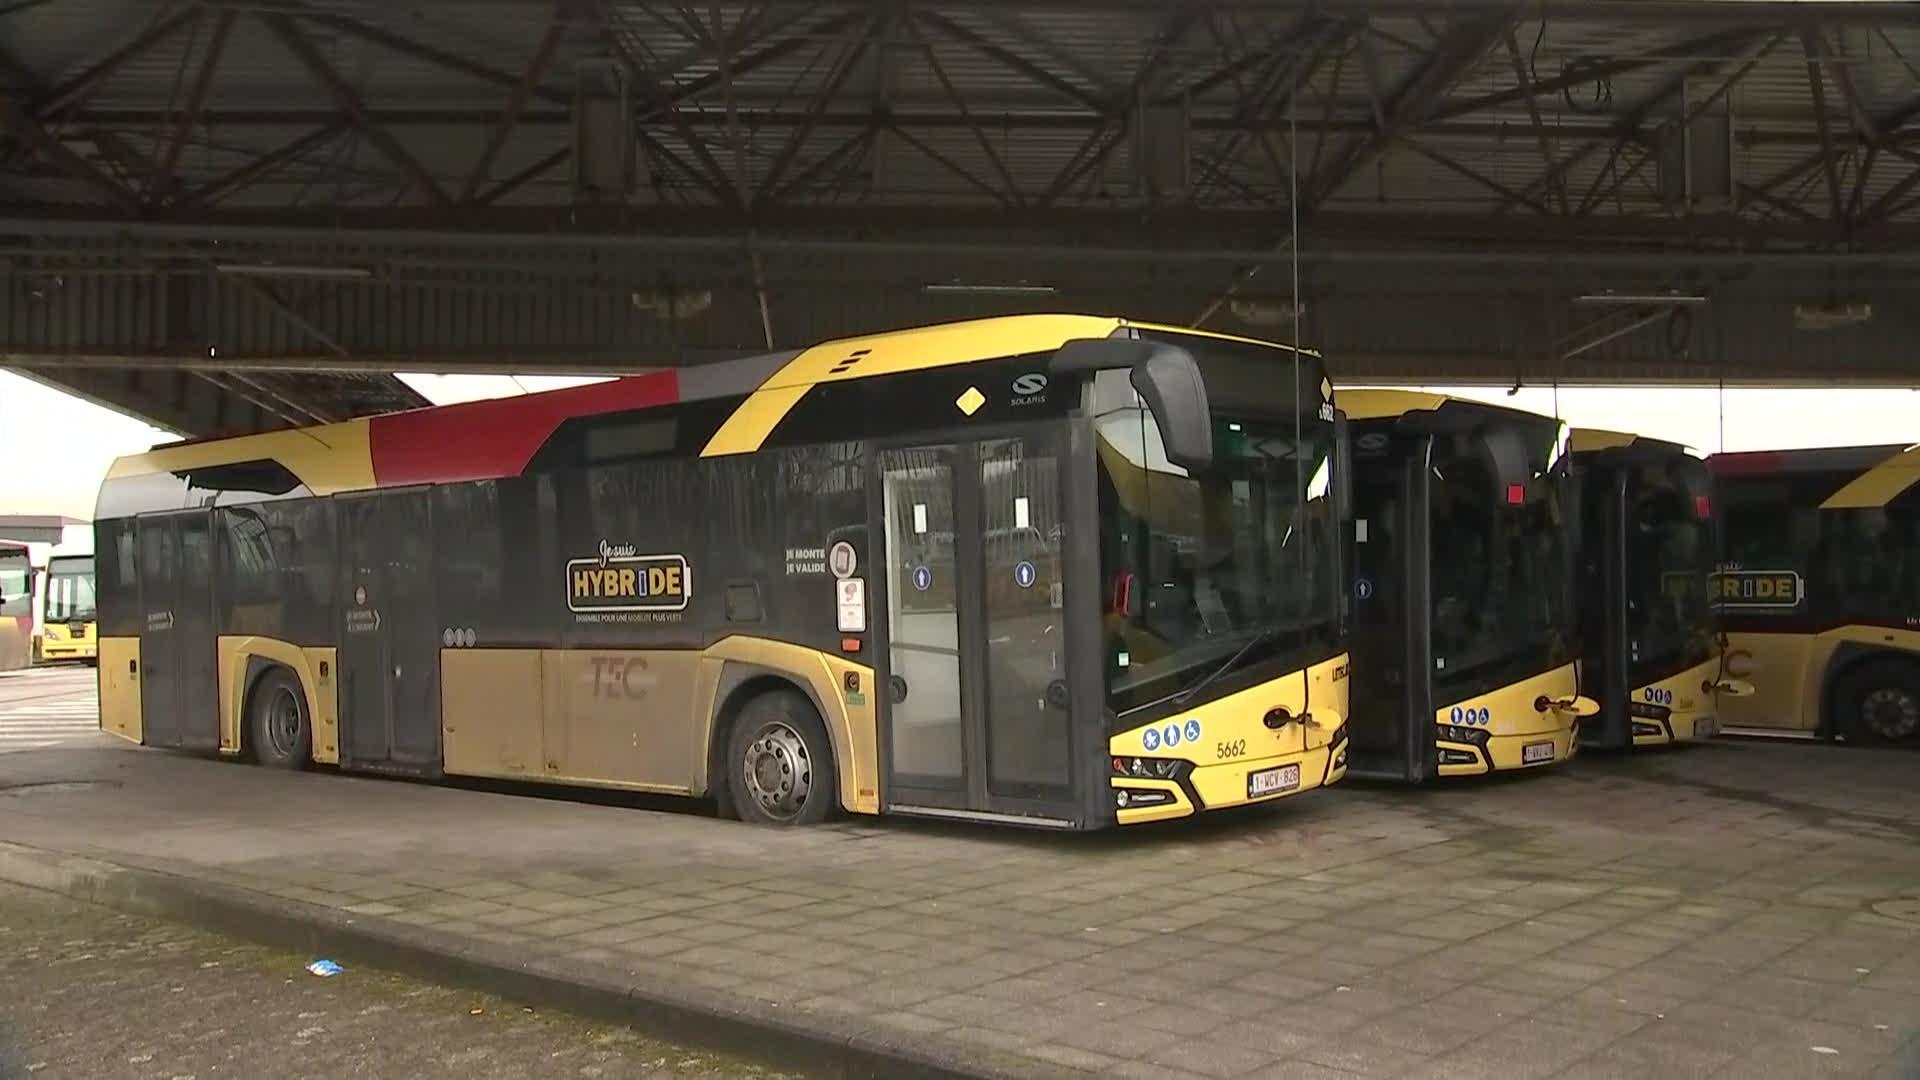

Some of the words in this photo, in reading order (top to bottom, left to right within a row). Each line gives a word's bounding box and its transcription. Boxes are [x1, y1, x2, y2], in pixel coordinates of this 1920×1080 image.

[1010, 395, 1046, 407] SOLARIS
[785, 548, 794, 561] JE
[795, 548, 825, 560] MONTE
[785, 563, 794, 575] JE
[796, 563, 825, 574] VALIDE
[574, 567, 681, 597] HYBRIDE
[652, 613, 665, 622] PLUS
[590, 656, 648, 700] TEC
[1217, 739, 1246, 759] 5662
